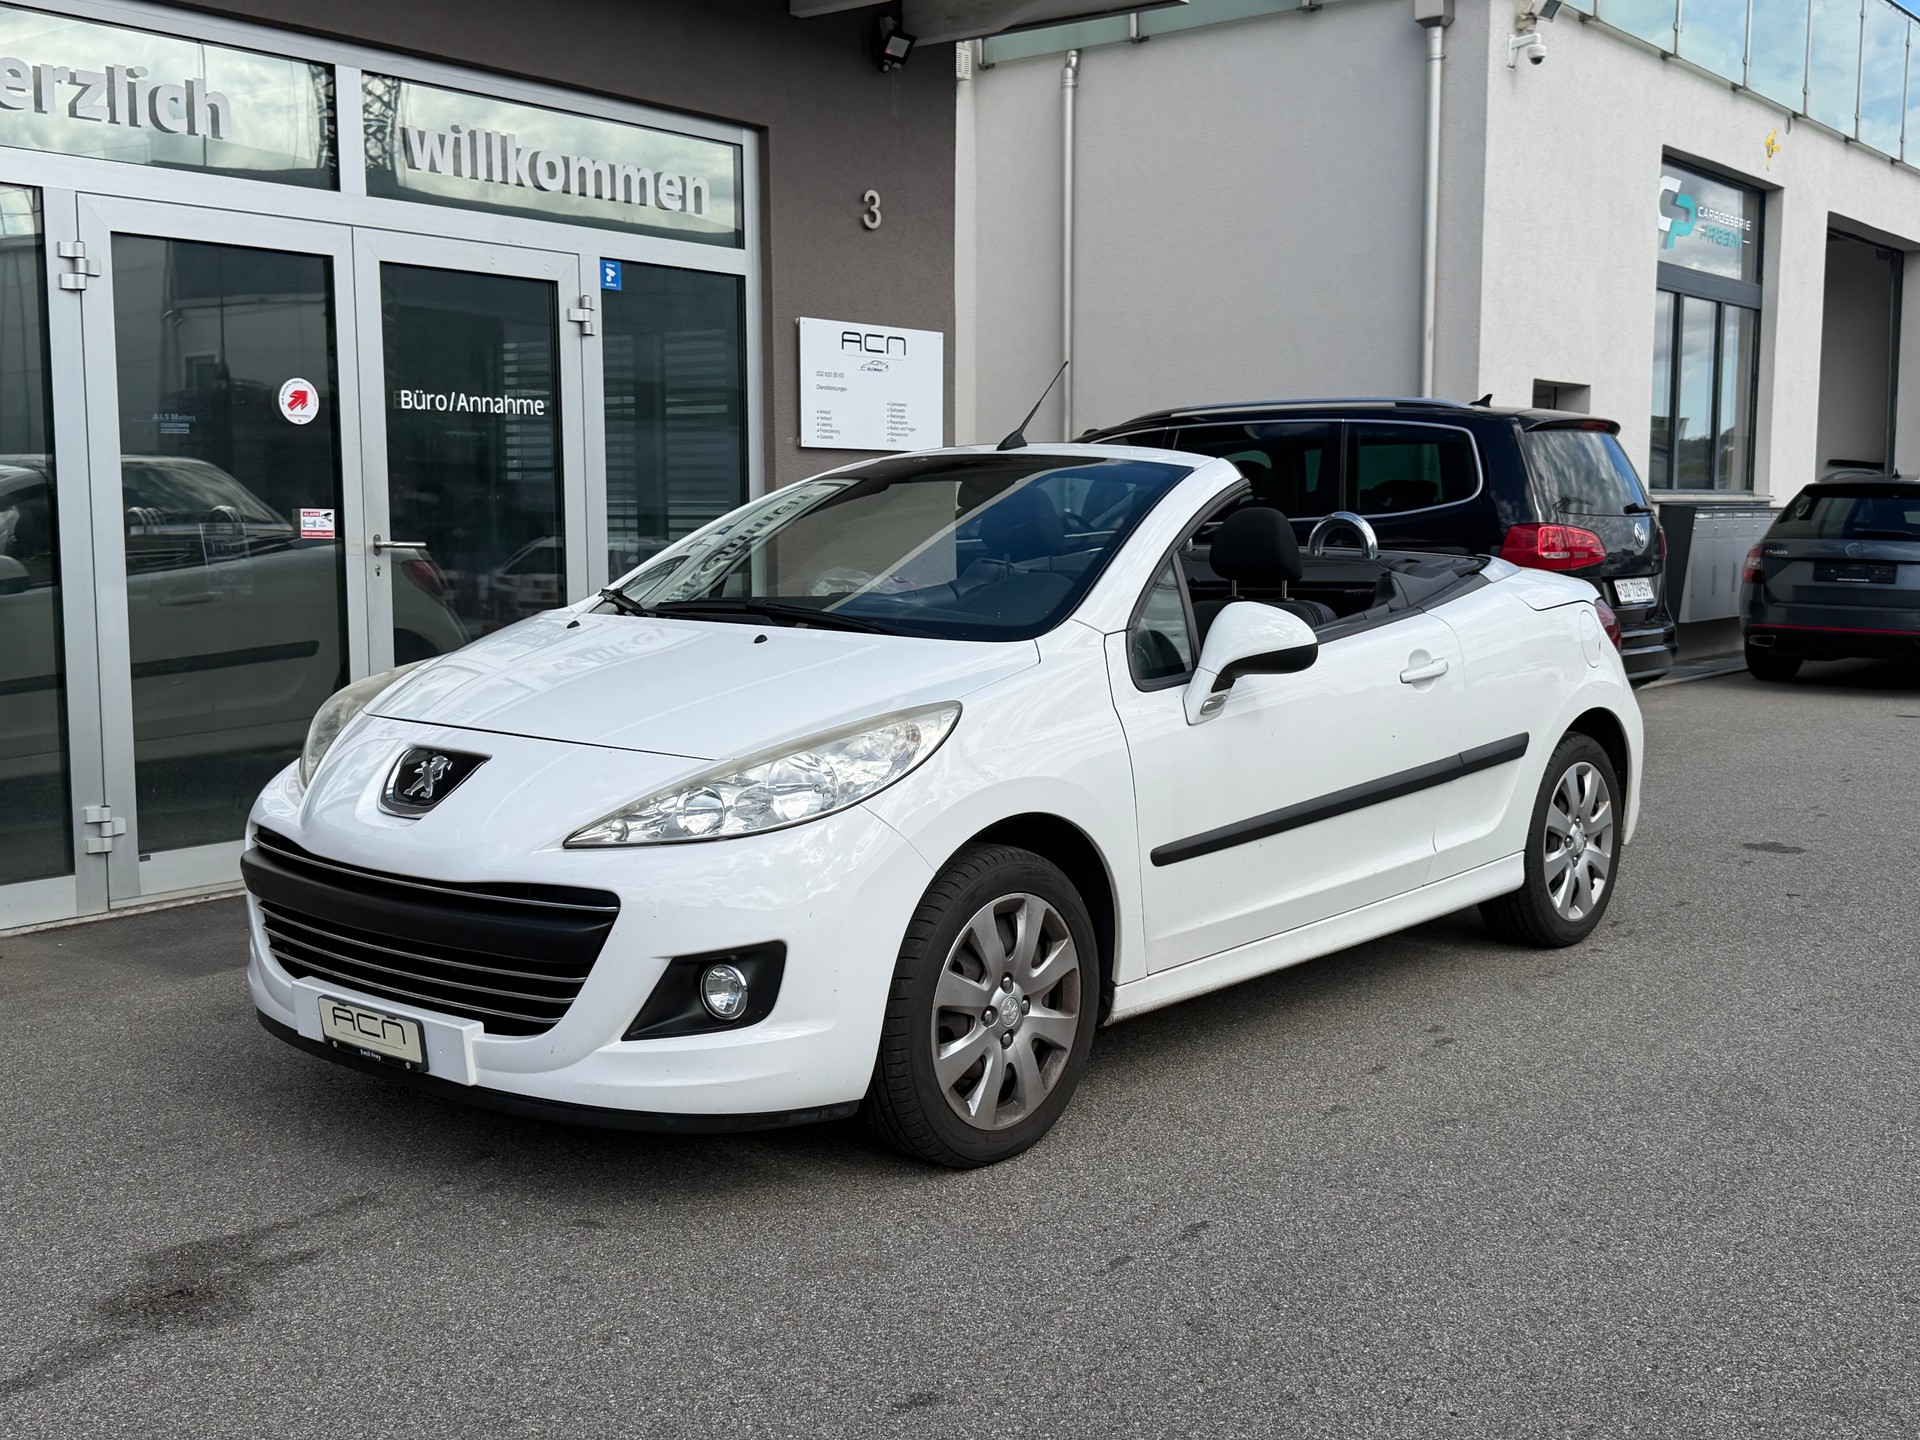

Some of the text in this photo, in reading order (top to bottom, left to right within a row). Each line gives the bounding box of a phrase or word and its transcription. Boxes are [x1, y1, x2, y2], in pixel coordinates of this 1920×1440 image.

[402, 124, 709, 215] willkommen
[863, 189, 882, 229] 3
[1697, 206, 1751, 231] CARROSSERIE
[842, 331, 906, 356] ACN
[400, 390, 545, 415] Büro/Annahme
[332, 1006, 407, 1046] ACN
